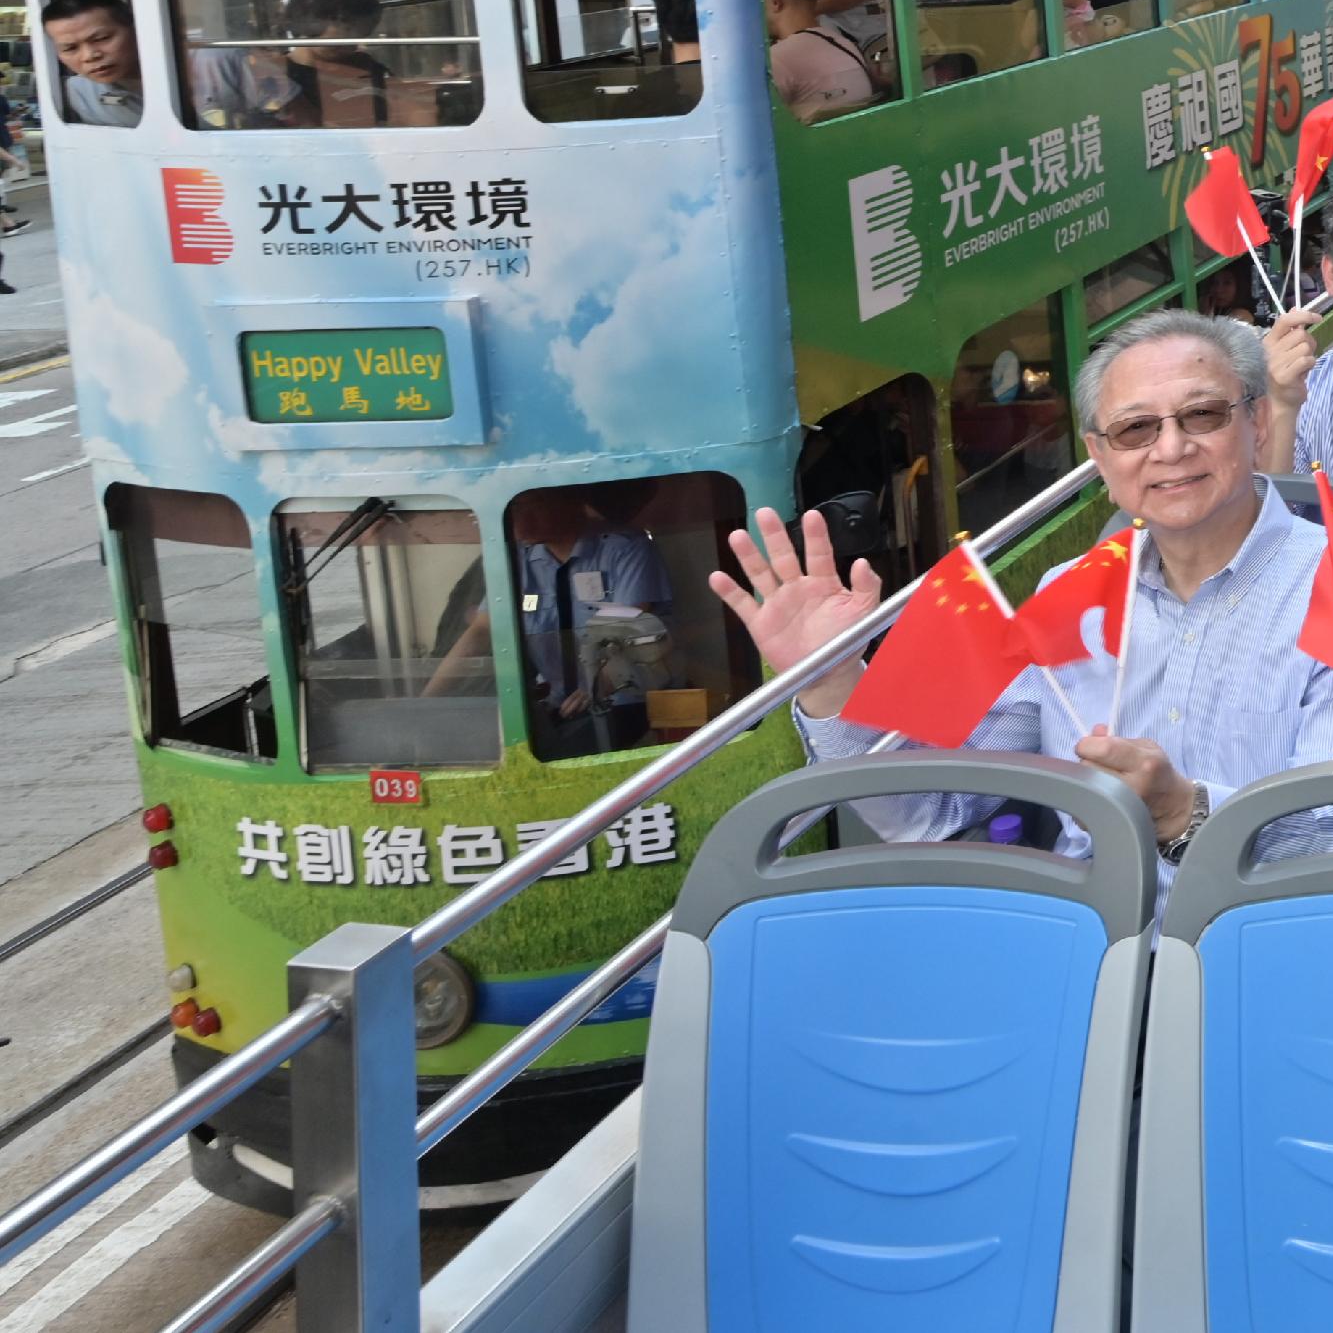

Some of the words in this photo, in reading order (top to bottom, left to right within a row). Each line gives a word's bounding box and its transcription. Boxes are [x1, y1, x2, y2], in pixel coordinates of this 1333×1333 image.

[1141, 59, 1244, 170] 慶祖國
[1238, 13, 1301, 167] 75
[941, 114, 1104, 238] 光大環境
[257, 178, 532, 237] 光大環境
[944, 216, 1025, 268] EVERBRIGHT
[1028, 181, 1105, 230] ENVIRONMENT
[1055, 206, 1110, 253] (257.HK)
[262, 241, 379, 257] EVERBRIGHT
[386, 235, 533, 255] ENVIRONMENT
[415, 256, 532, 281] (257.HK)
[251, 349, 343, 381] Happy
[353, 348, 443, 380] Valley
[375, 778, 418, 798] 039
[236, 802, 677, 884] 共創綠色香港
